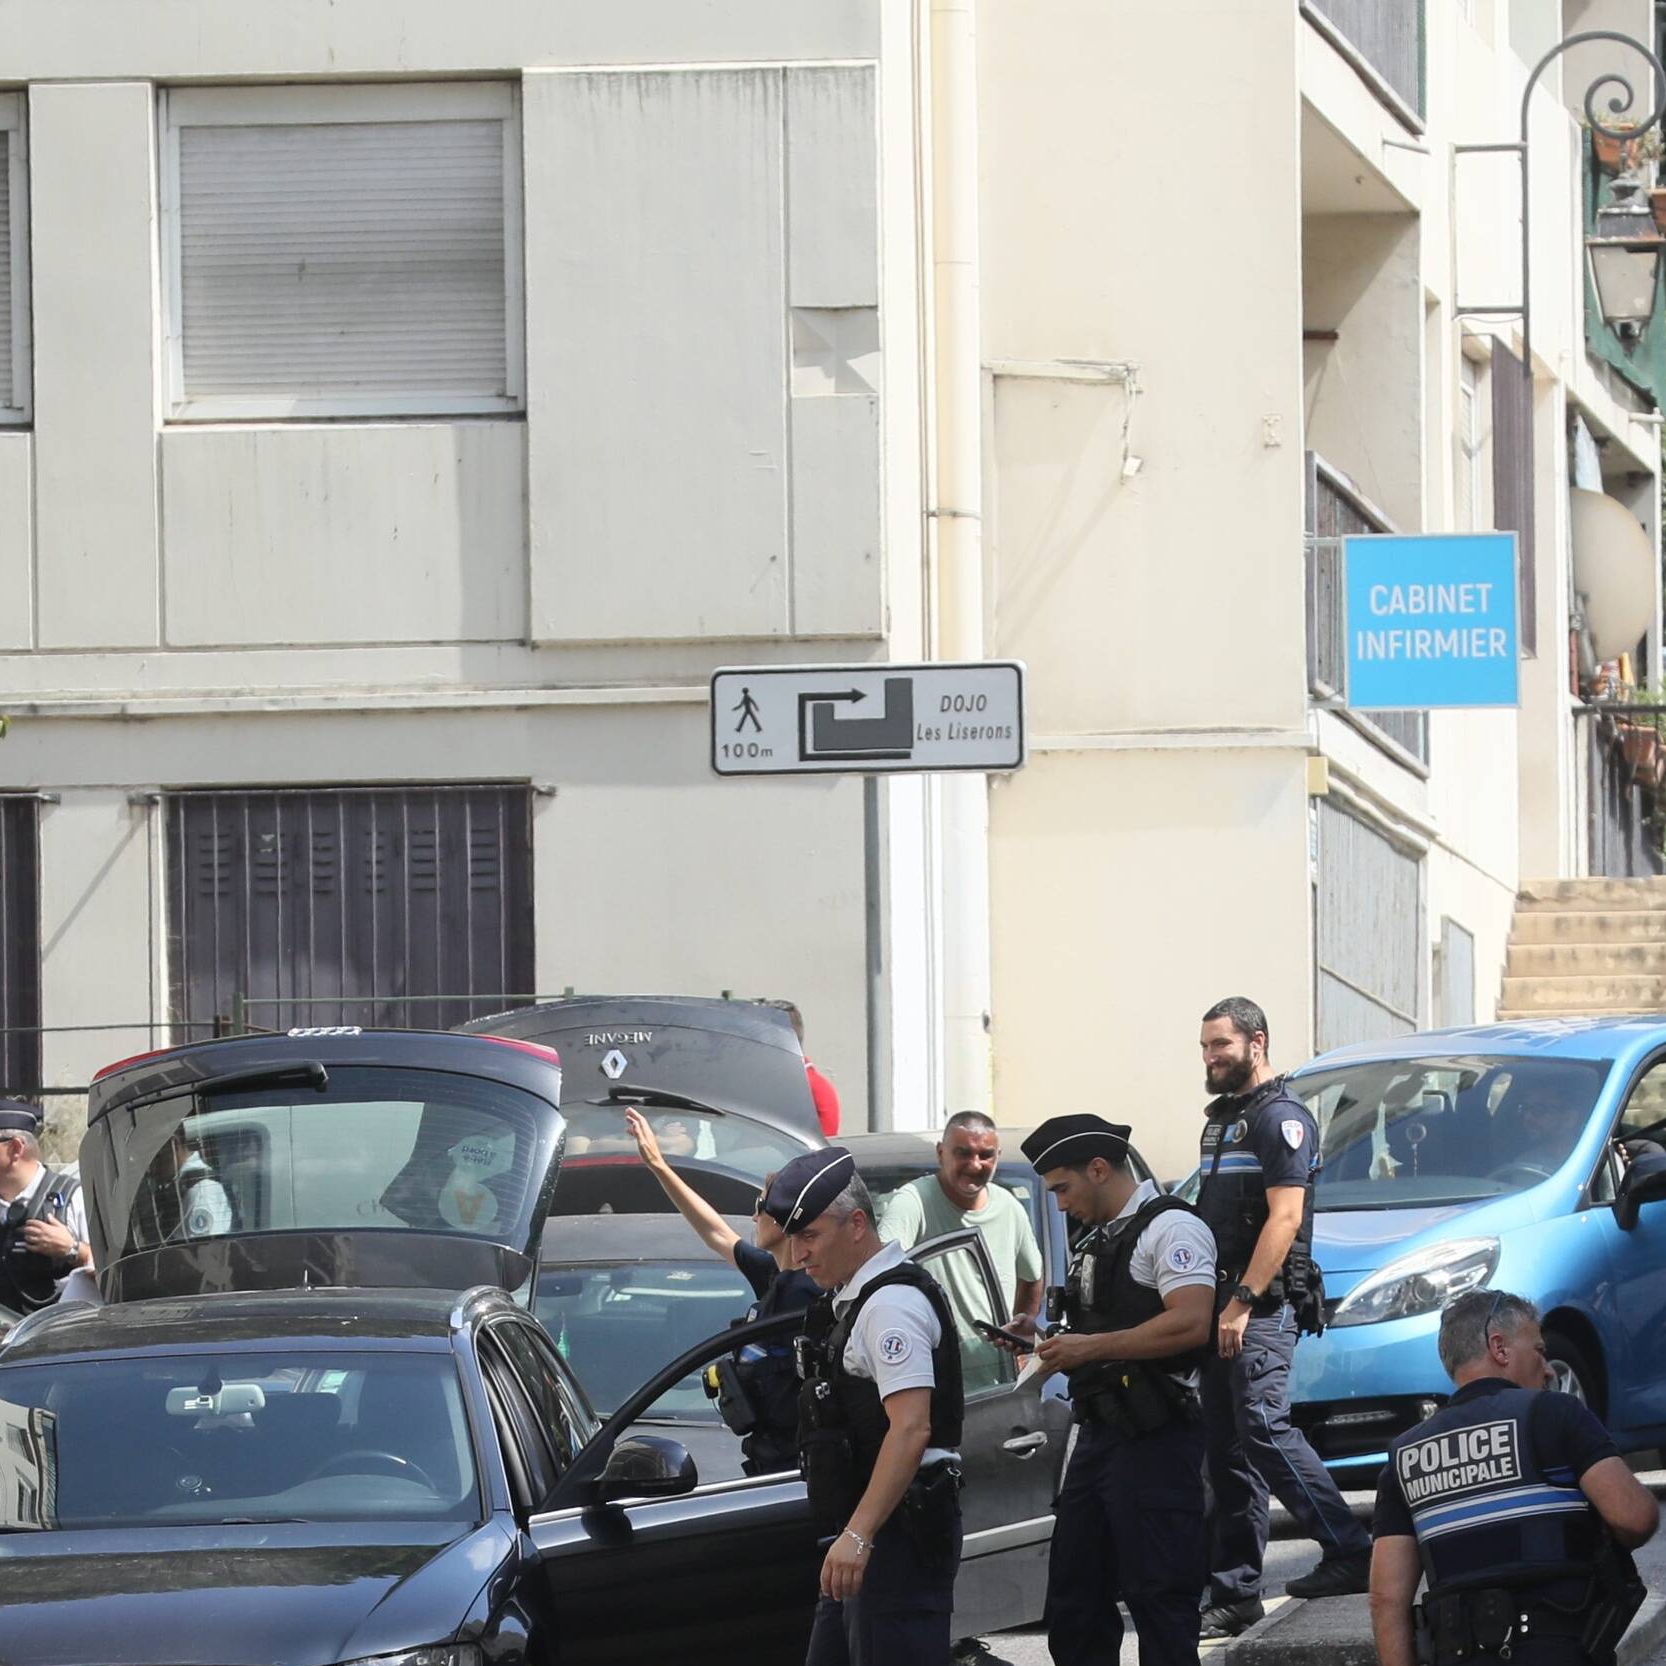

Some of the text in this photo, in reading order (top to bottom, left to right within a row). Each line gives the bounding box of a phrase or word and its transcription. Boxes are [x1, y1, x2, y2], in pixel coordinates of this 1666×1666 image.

[1369, 583, 1493, 616] CABINET
[1357, 628, 1507, 660] INFIRMIER
[940, 695, 987, 712] DOJO
[917, 722, 1012, 741] Les Liserons
[721, 743, 773, 758] 100m
[584, 1031, 653, 1047] MEGANE
[1401, 1425, 1511, 1479] POLICE
[1405, 1456, 1514, 1501] MUNICIPALE
